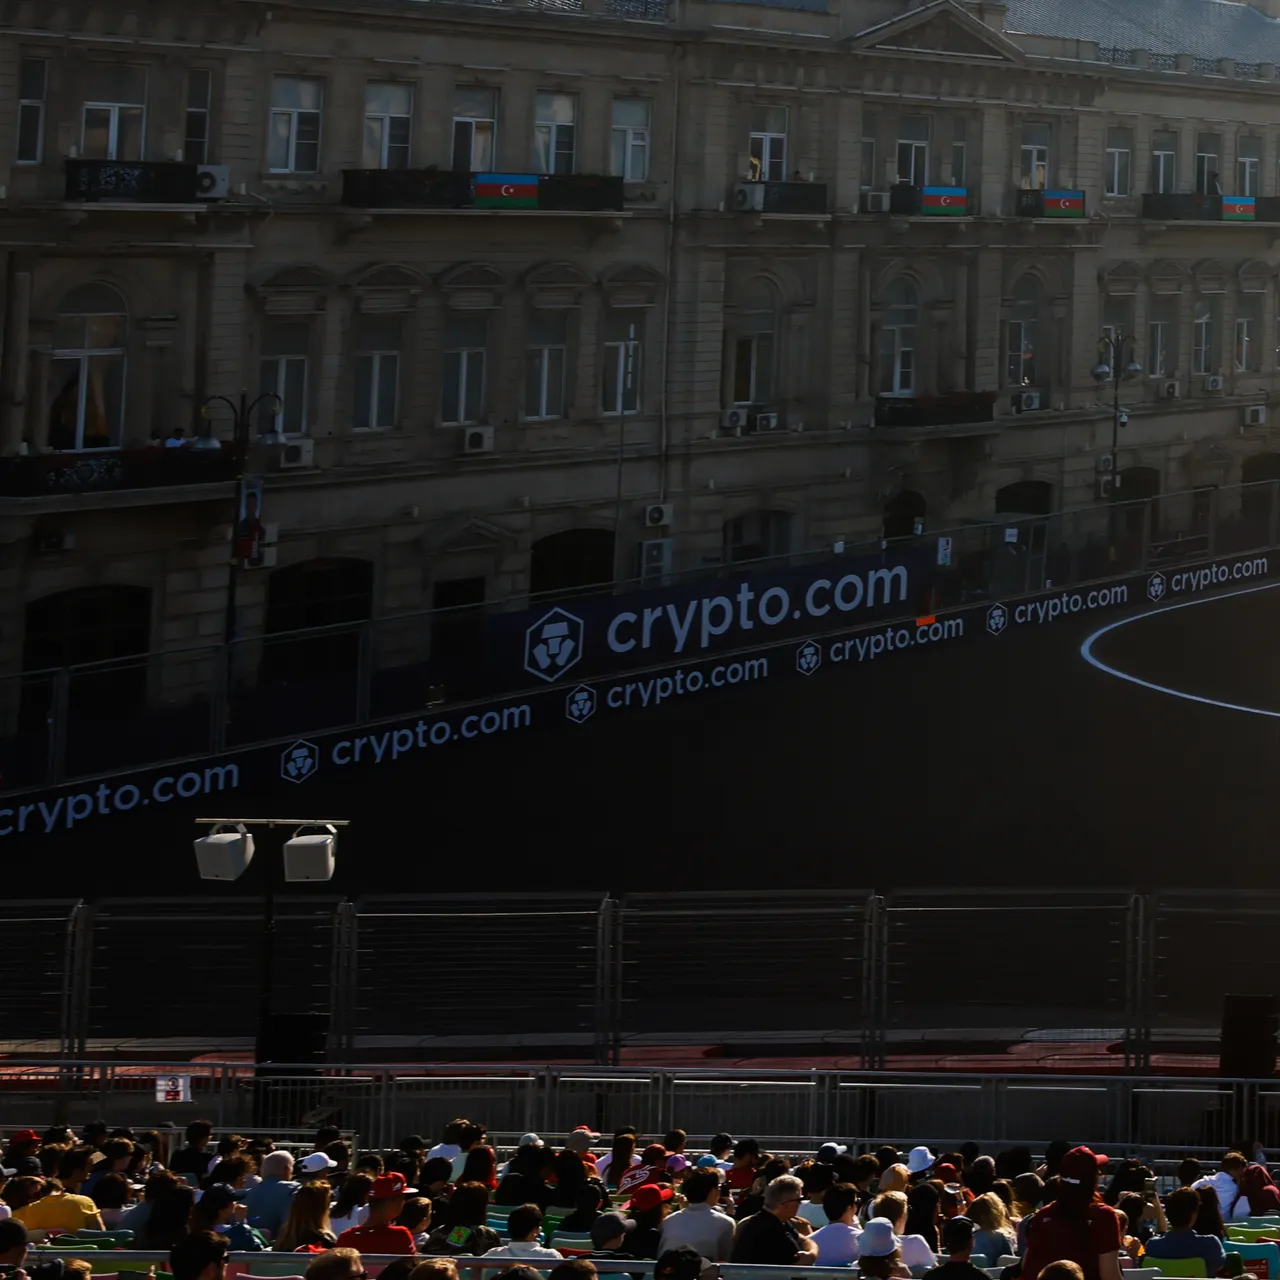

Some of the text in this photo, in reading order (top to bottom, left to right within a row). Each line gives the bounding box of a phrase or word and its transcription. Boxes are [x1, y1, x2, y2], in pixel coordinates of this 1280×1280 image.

[1170, 556, 1268, 592] crypto.com
[606, 565, 908, 653] crypto.com
[1014, 583, 1128, 624] crypto.com
[830, 616, 964, 663] crypto.com
[606, 656, 768, 708] crypto.com
[332, 703, 531, 766] crypto.com
[0, 762, 240, 836] crypto.com
